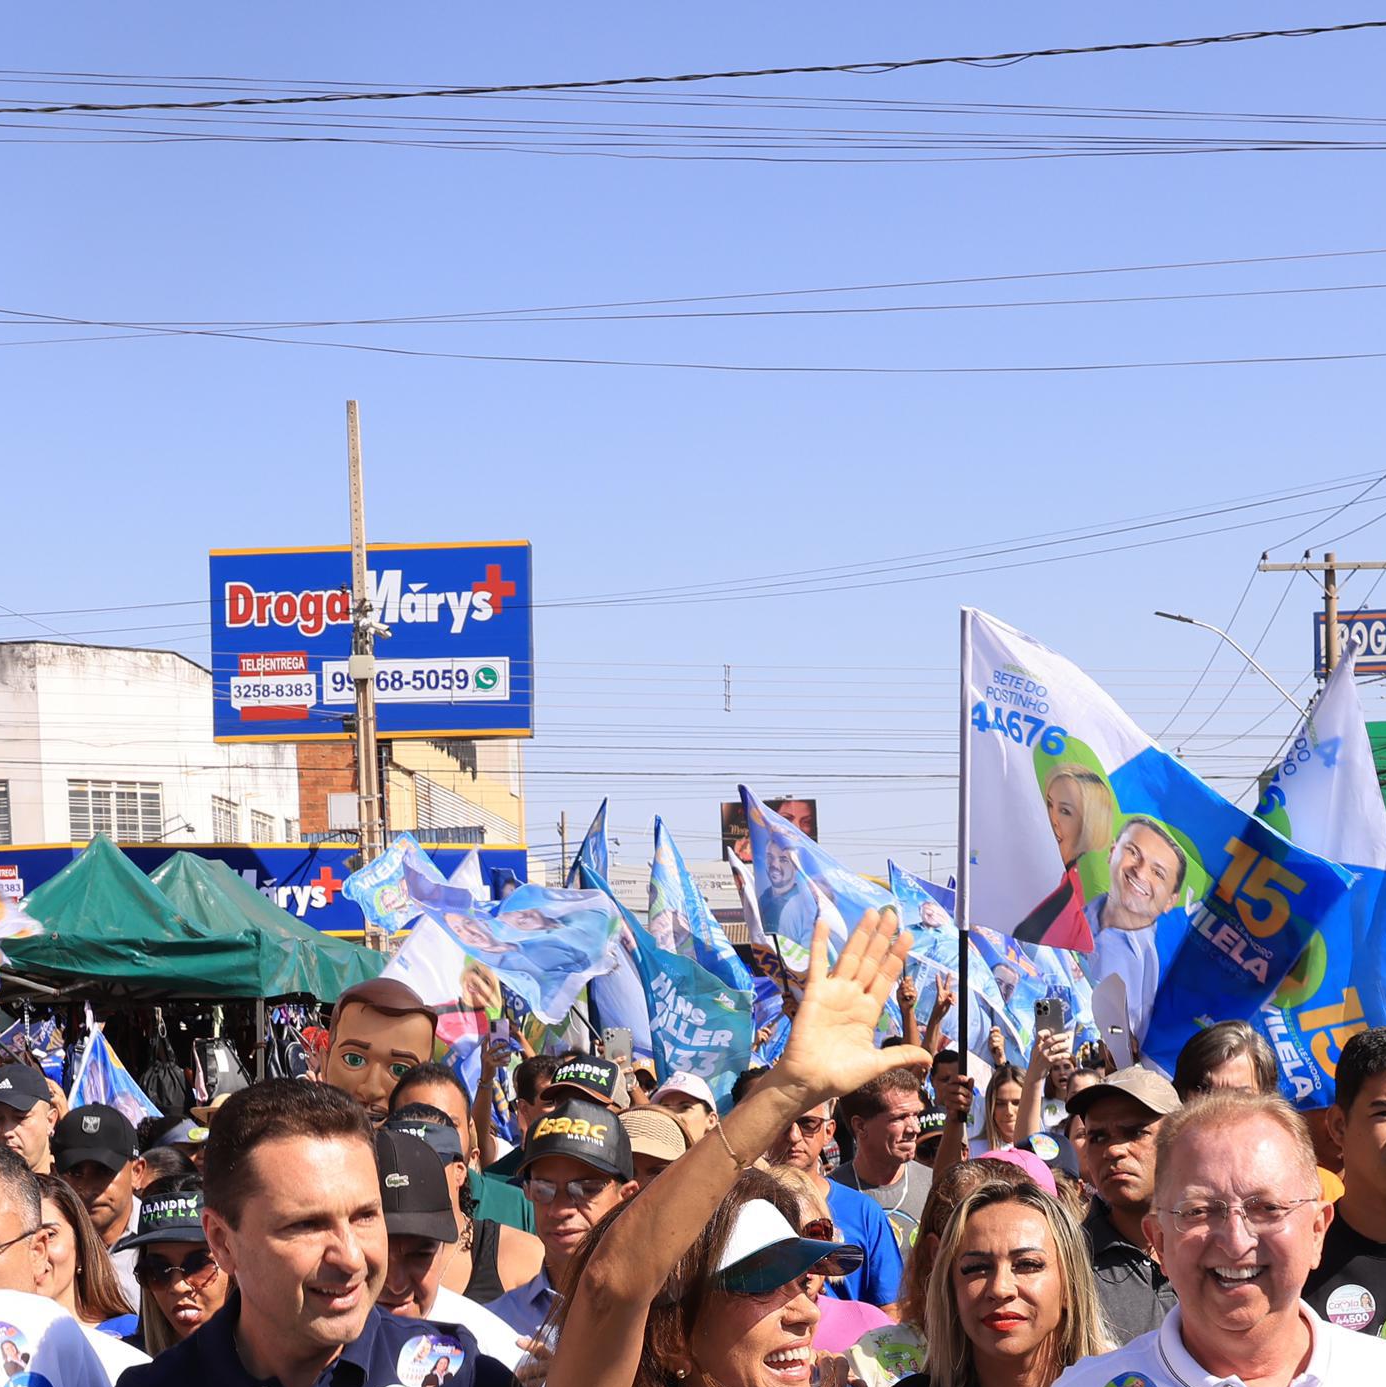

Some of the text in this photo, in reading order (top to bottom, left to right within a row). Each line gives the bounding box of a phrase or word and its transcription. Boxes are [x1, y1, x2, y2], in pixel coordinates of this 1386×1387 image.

[241, 656, 305, 672] TELE-ENTREGA
[232, 667, 470, 699] 3258-8383 9968-5059
[993, 670, 1024, 690] BETE
[1024, 680, 1048, 698] DO
[985, 685, 1050, 714] POSTINHO
[1214, 835, 1308, 939] 15
[1184, 883, 1270, 985] VILELA
[650, 970, 707, 1026] HANS
[1297, 985, 1369, 1080] 15
[1259, 991, 1314, 1105] VILELA
[1297, 1046, 1322, 1091] LEANDRO
[532, 1116, 608, 1141] Isaac
[567, 1133, 605, 1147] MARTINS
[141, 1196, 201, 1216] LEANDRO
[142, 1207, 200, 1223] VILELA
[1335, 1312, 1370, 1325] 44500
